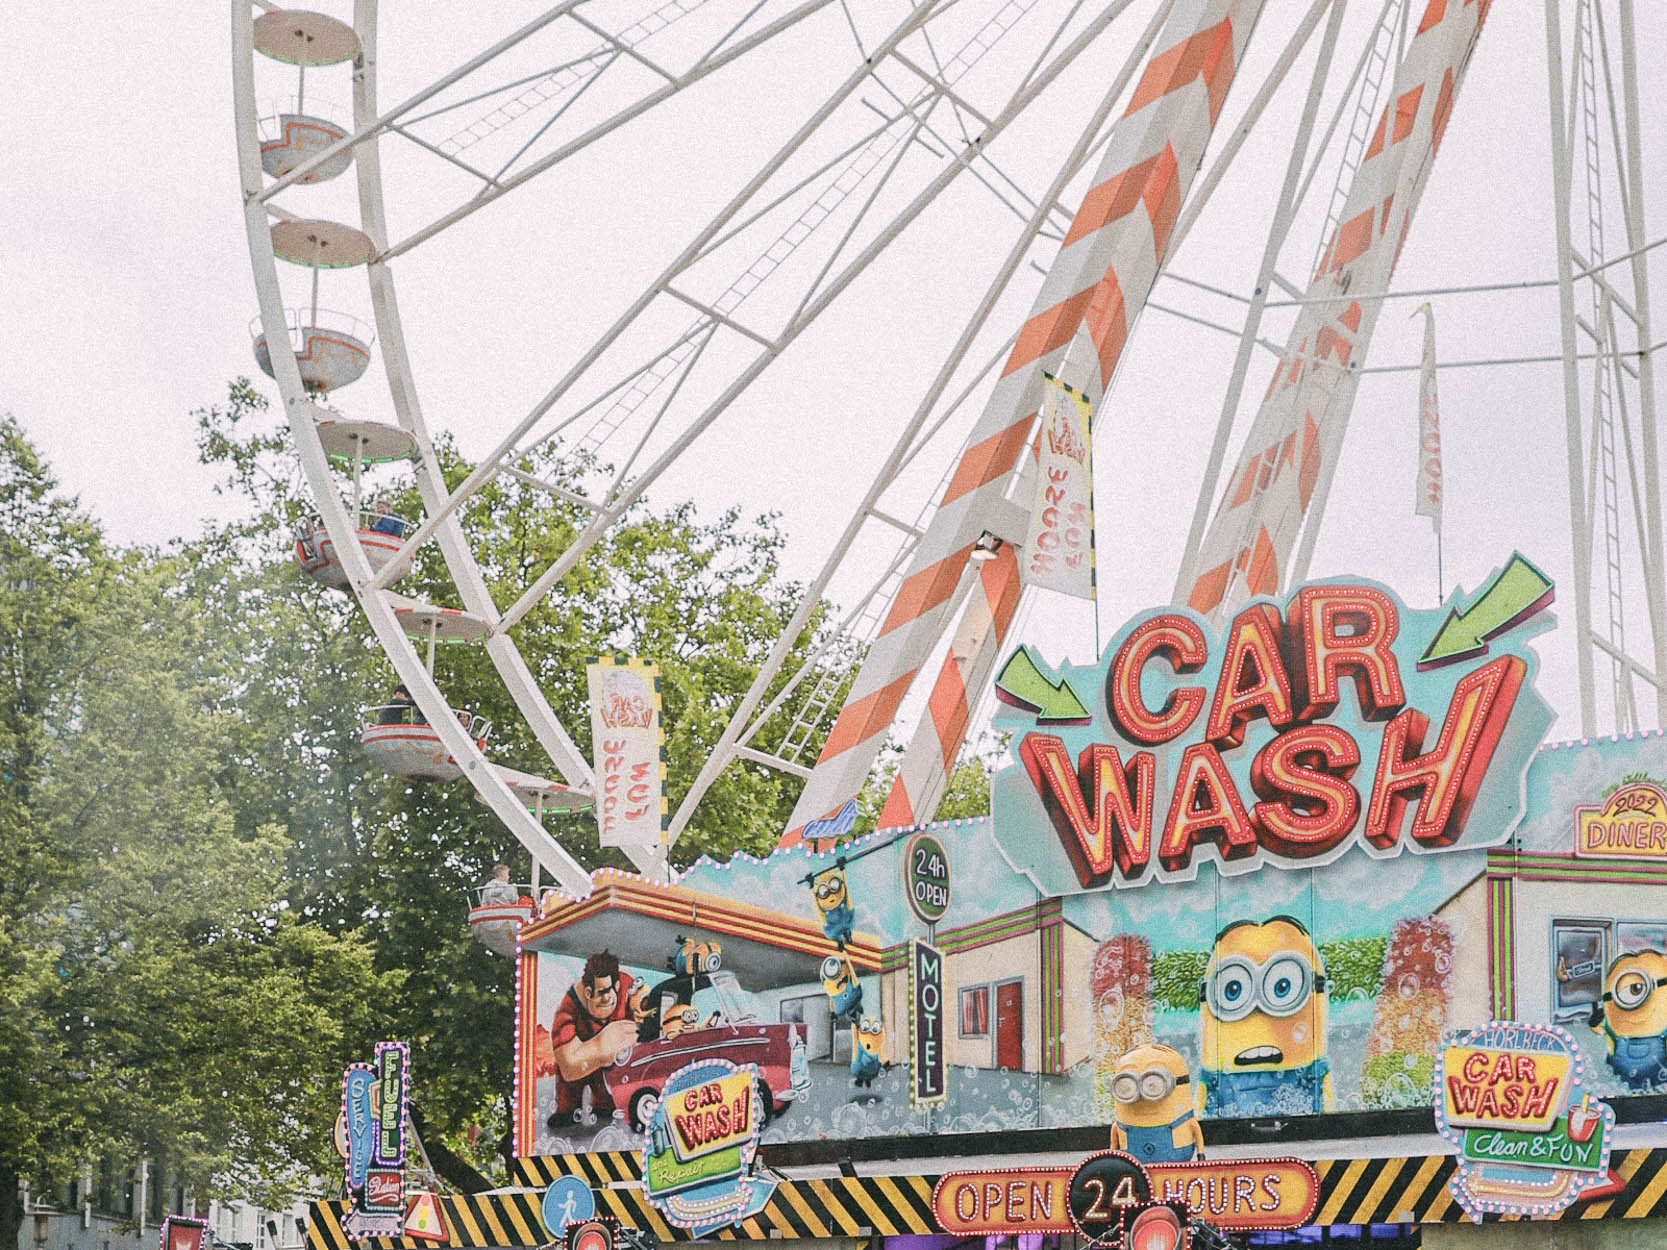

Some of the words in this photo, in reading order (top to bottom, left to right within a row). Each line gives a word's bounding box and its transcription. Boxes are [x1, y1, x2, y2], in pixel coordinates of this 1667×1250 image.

[1107, 584, 1405, 750] CAR
[1018, 655, 1527, 888] WASH
[1613, 793, 1658, 817] 2022
[1587, 821, 1667, 849] DINER
[916, 849, 945, 879] 24h
[916, 881, 947, 906] OPEN
[920, 953, 939, 1092] MOTEL
[1484, 1029, 1555, 1050] HORLBECK
[1464, 1052, 1535, 1086] CAR
[381, 1051, 400, 1157] FUEL
[674, 1085, 750, 1151] WASH
[684, 1083, 723, 1112] CAR
[1448, 1076, 1559, 1119] WASH
[351, 1079, 366, 1178] SERVICE
[955, 1181, 1052, 1223] OPEN
[1082, 1174, 1137, 1223] 24
[1163, 1173, 1281, 1215] HOURS
